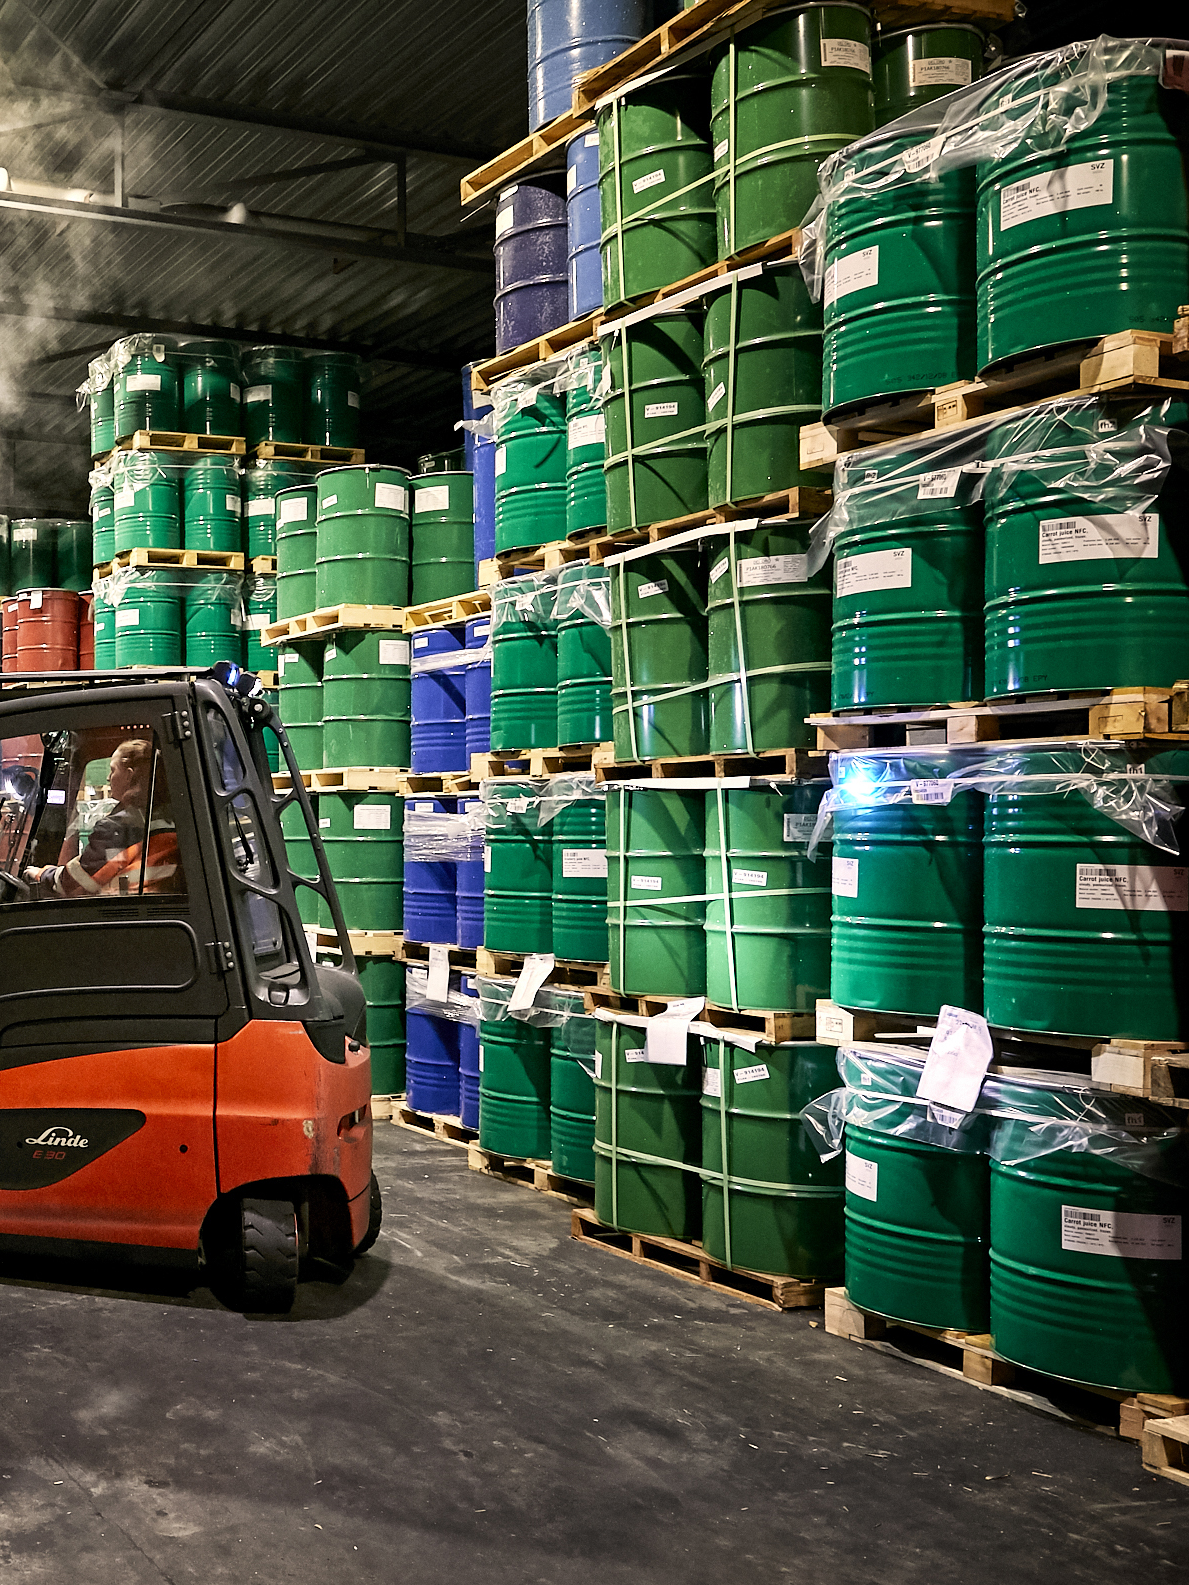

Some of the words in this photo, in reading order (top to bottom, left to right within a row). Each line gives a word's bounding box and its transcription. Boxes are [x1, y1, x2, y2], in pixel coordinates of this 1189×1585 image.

[1091, 162, 1105, 170] SVZ
[25, 1126, 89, 1148] Linde
[32, 1150, 44, 1159] E
[45, 1151, 66, 1160] 30
[1064, 1217, 1082, 1225] Carrot
